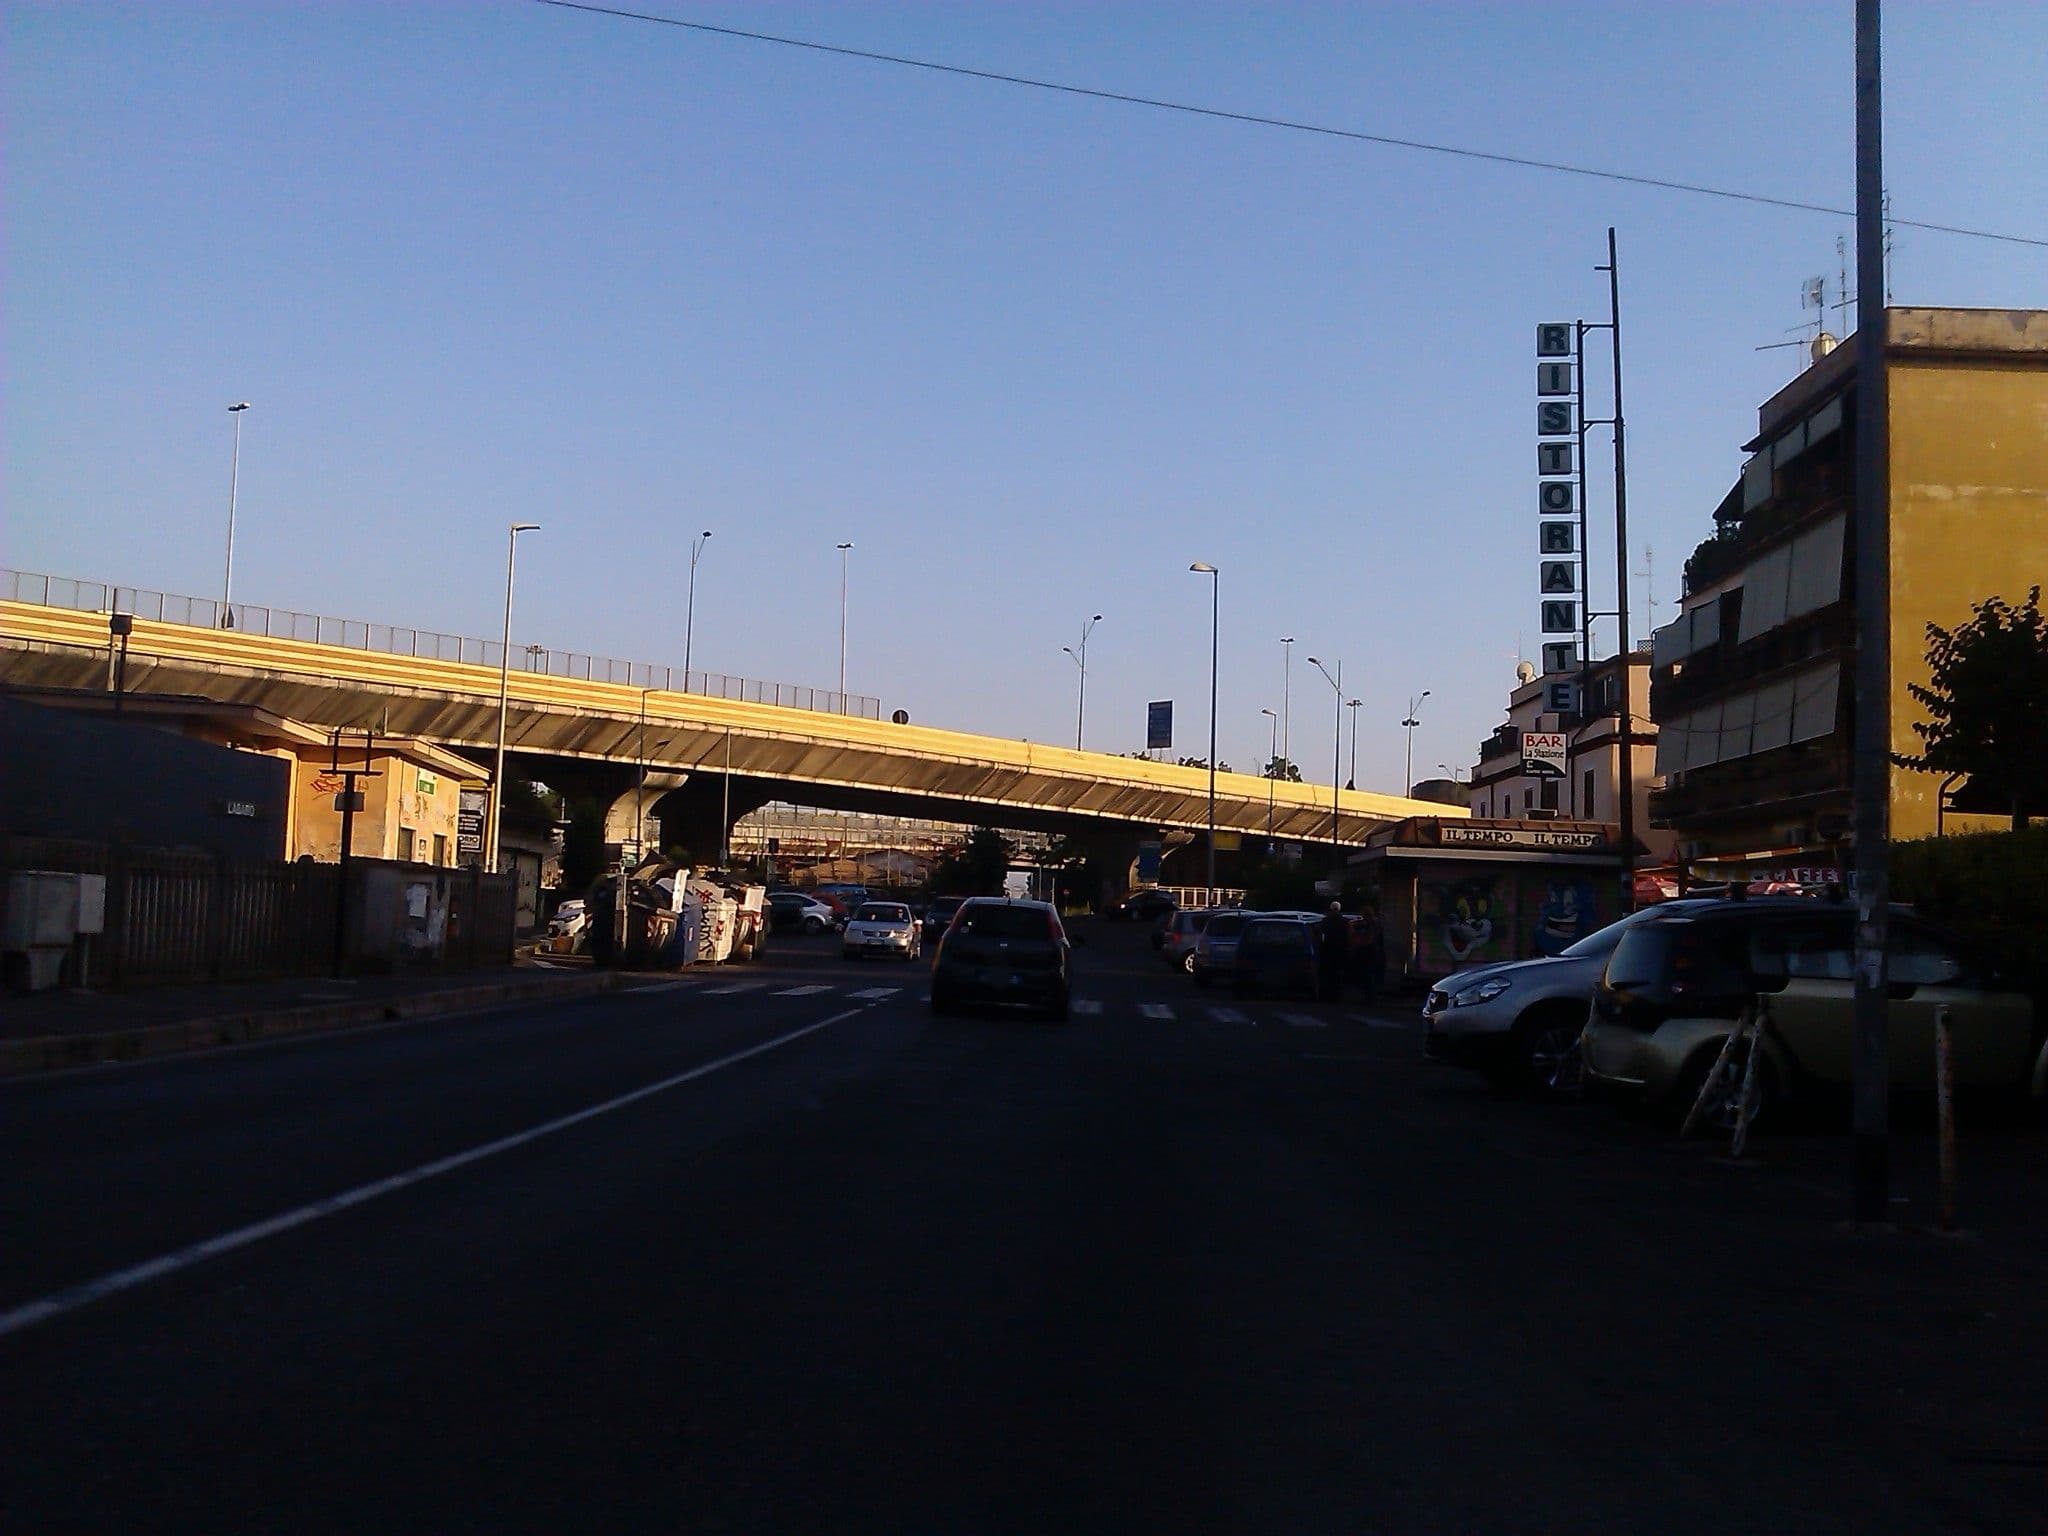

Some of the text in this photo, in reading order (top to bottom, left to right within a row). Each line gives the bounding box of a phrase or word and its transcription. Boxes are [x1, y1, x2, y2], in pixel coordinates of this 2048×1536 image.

[1542, 325, 1572, 710] RISTORANTE
[1525, 735, 1563, 747] BAR
[1446, 829, 1601, 846] IL TEMPO IL TEMPO
